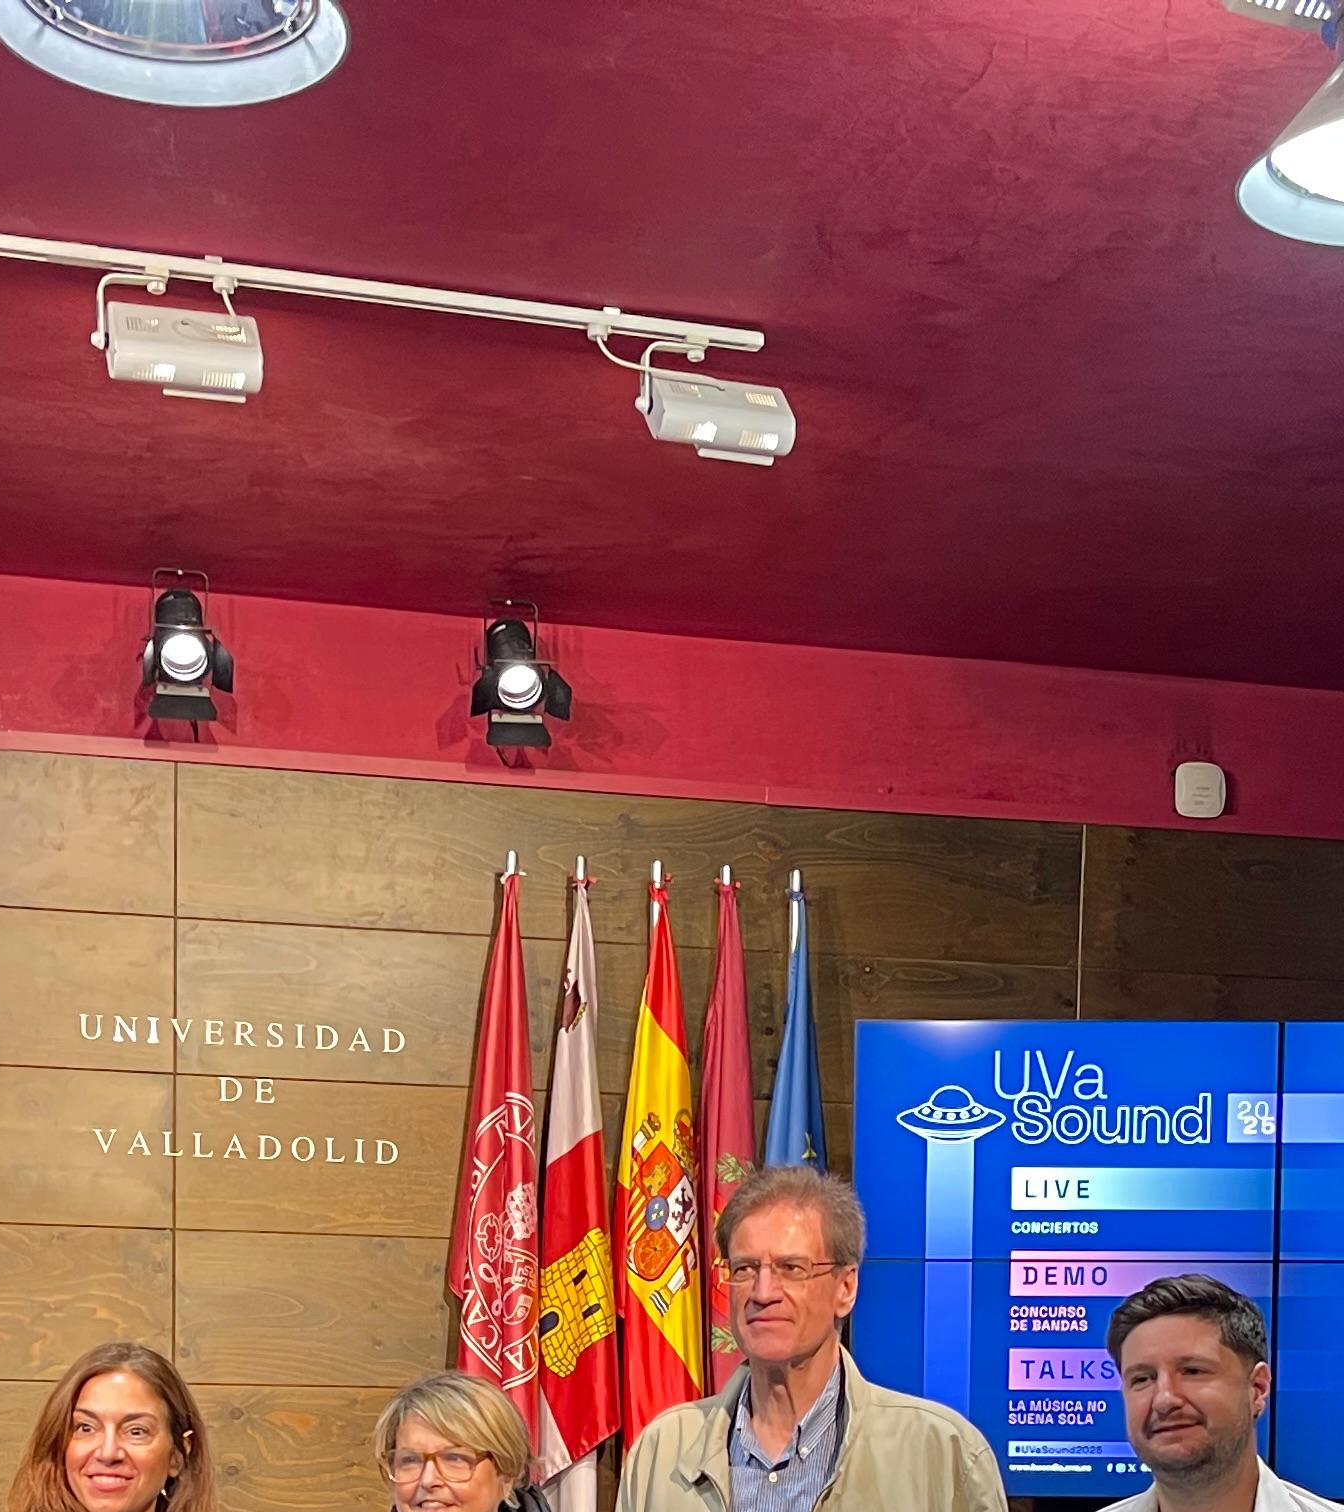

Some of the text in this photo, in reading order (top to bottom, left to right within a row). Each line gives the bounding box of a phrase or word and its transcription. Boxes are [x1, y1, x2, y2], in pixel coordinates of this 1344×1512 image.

[78, 1012, 407, 1054] UNIVERSIDAD
[993, 1050, 1108, 1100] UVa
[218, 1076, 276, 1105] DE
[1011, 1091, 1213, 1145] Sound
[92, 1127, 400, 1165] VALLADOLID
[1025, 1179, 1091, 1199] LIVE
[1011, 1221, 1099, 1234] CONCIERTOS
[1022, 1266, 1108, 1286] DEMO
[1010, 1306, 1086, 1318] CONCURSO
[1010, 1319, 1089, 1332] DE BANDAS
[1020, 1360, 1116, 1380] TALKS
[1008, 1397, 1107, 1412] LA MÚSICA NO
[1008, 1413, 1095, 1425] SUENA SOLA
